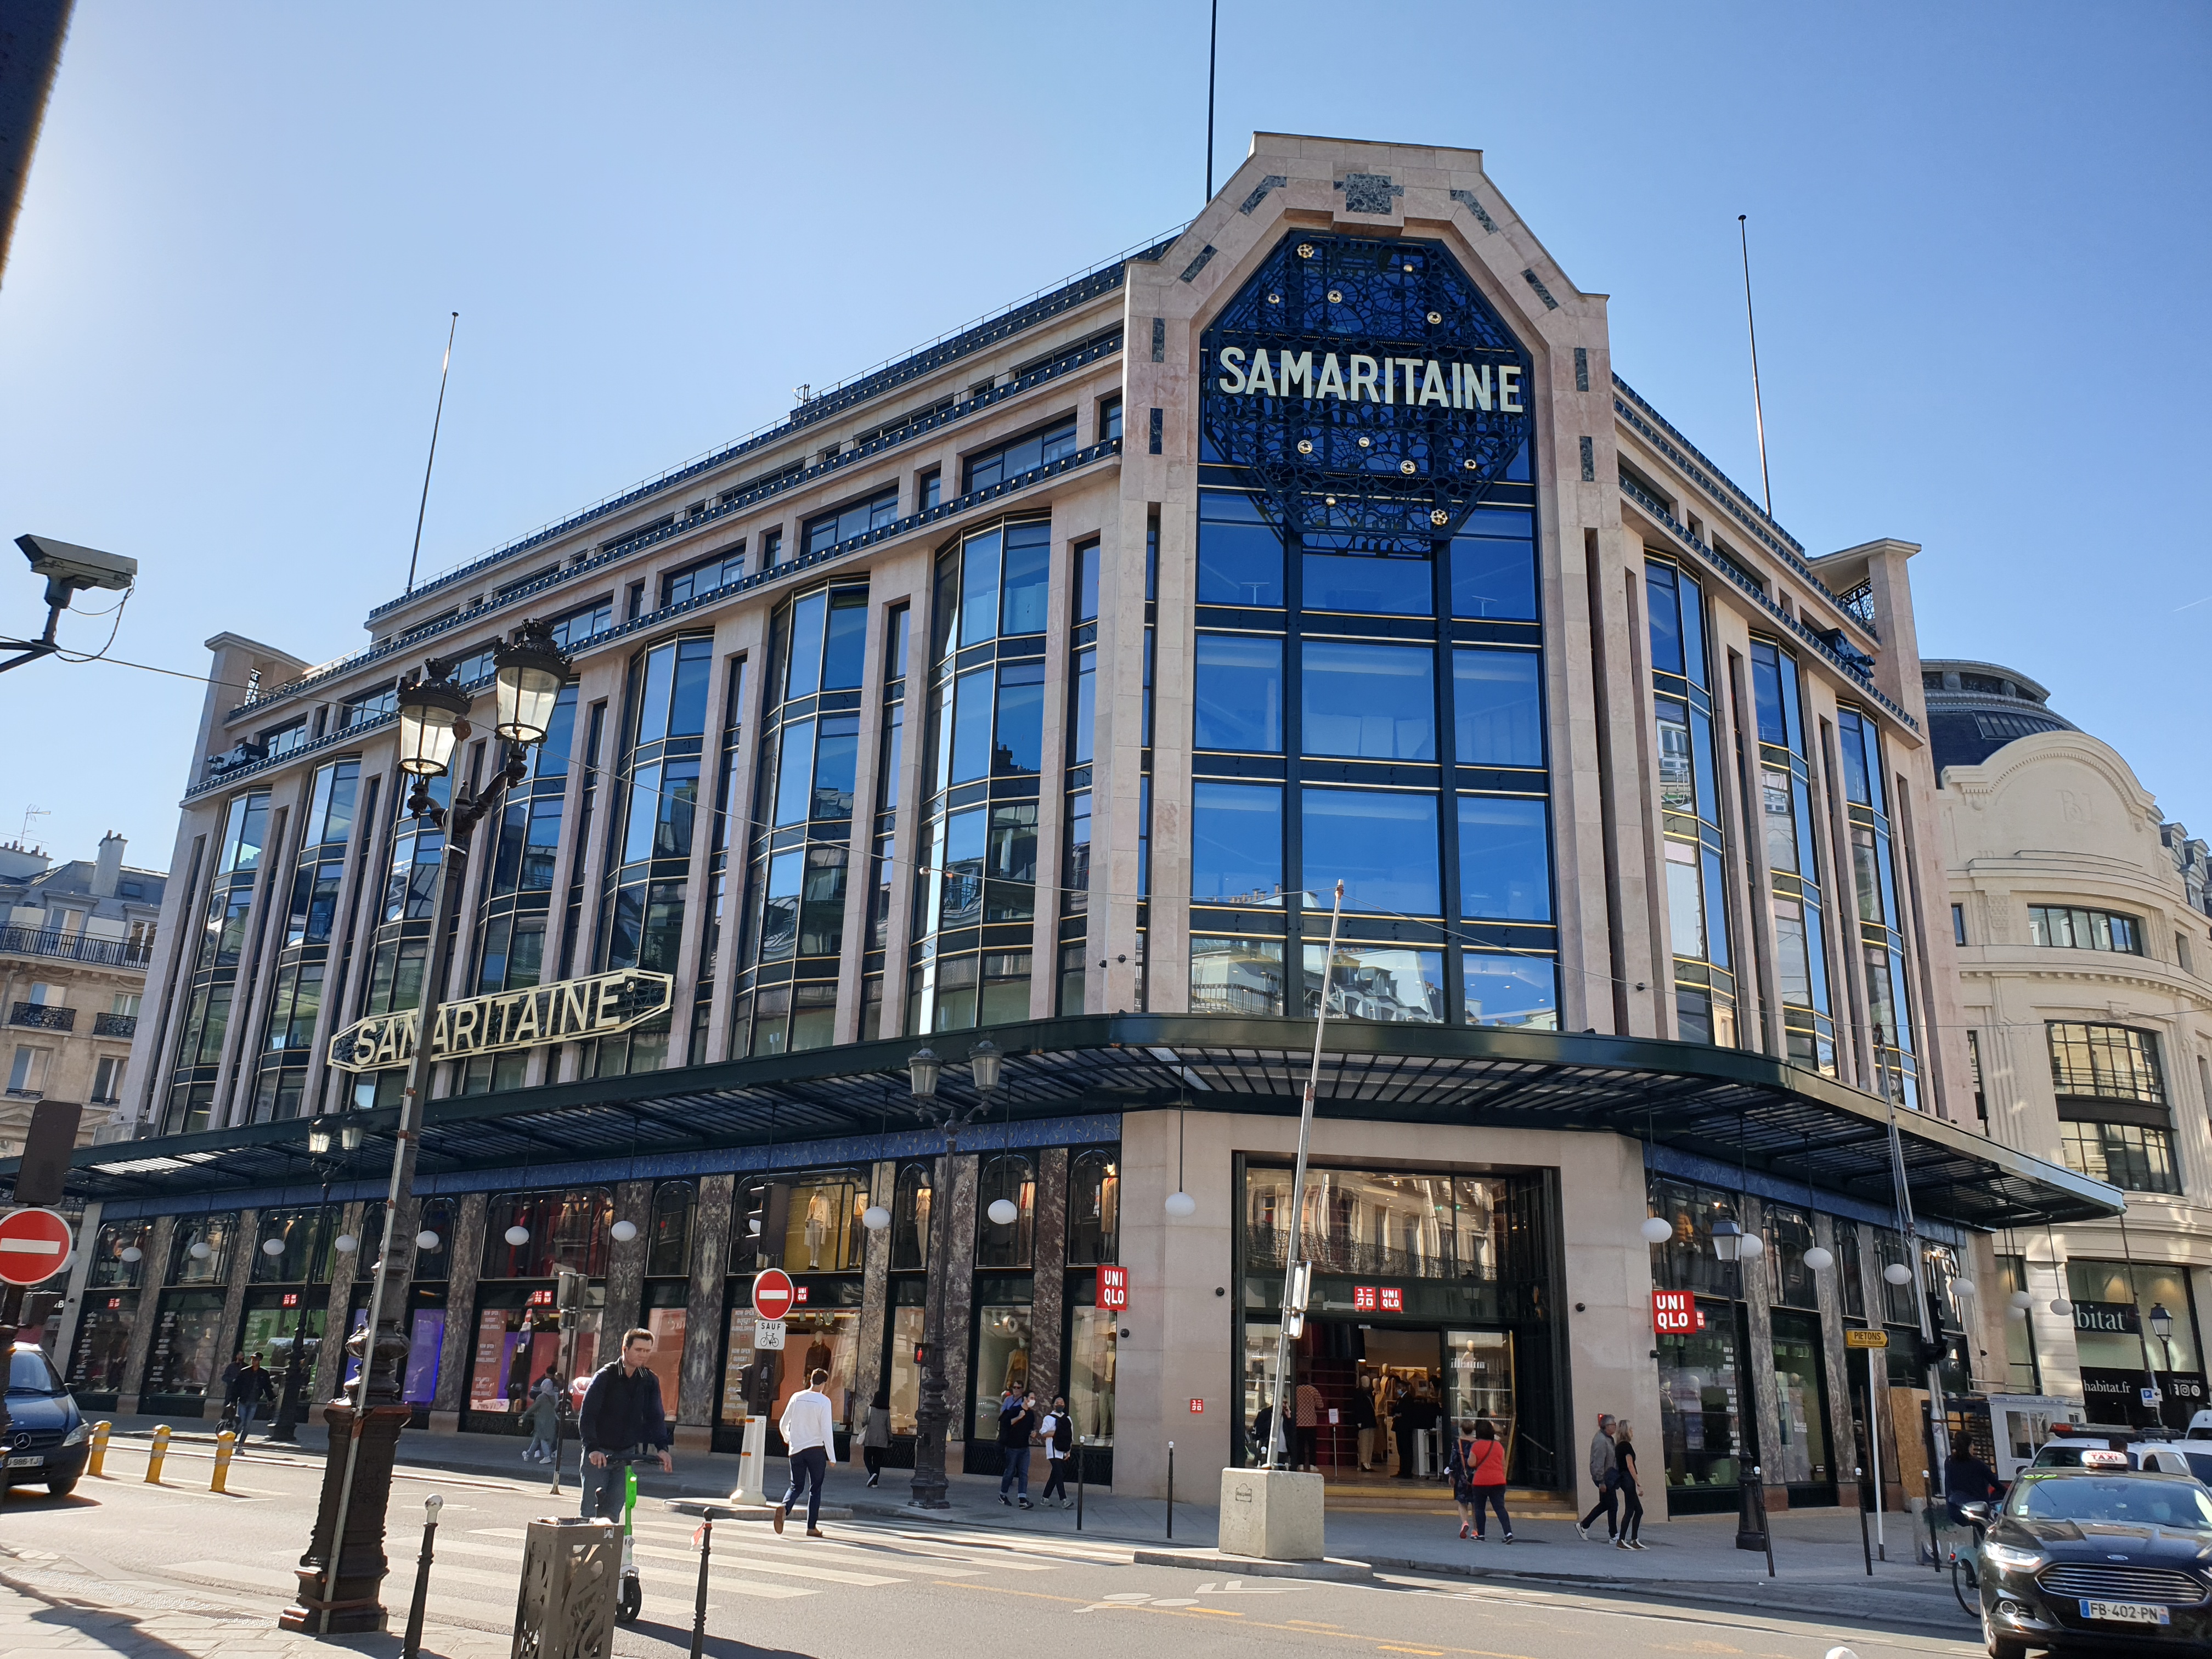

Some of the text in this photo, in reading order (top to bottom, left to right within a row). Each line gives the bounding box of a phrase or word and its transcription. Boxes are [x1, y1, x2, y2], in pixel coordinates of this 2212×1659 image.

[1219, 347, 1523, 413] SAMARITAINE
[1104, 1269, 1123, 1286] UNI
[1104, 1288, 1124, 1306] QLO
[1382, 1289, 1398, 1299] UNI
[1656, 1294, 1685, 1310] UNI
[1383, 1298, 1399, 1308] QLO
[1657, 1312, 1688, 1330] QLO
[2074, 1304, 2126, 1330] bitat
[761, 1322, 781, 1330] SAUF
[1854, 1331, 1881, 1340] PIETONS
[2084, 1379, 2131, 1393] habitat.fr
[2090, 1602, 2158, 1620] FB-402-PN
